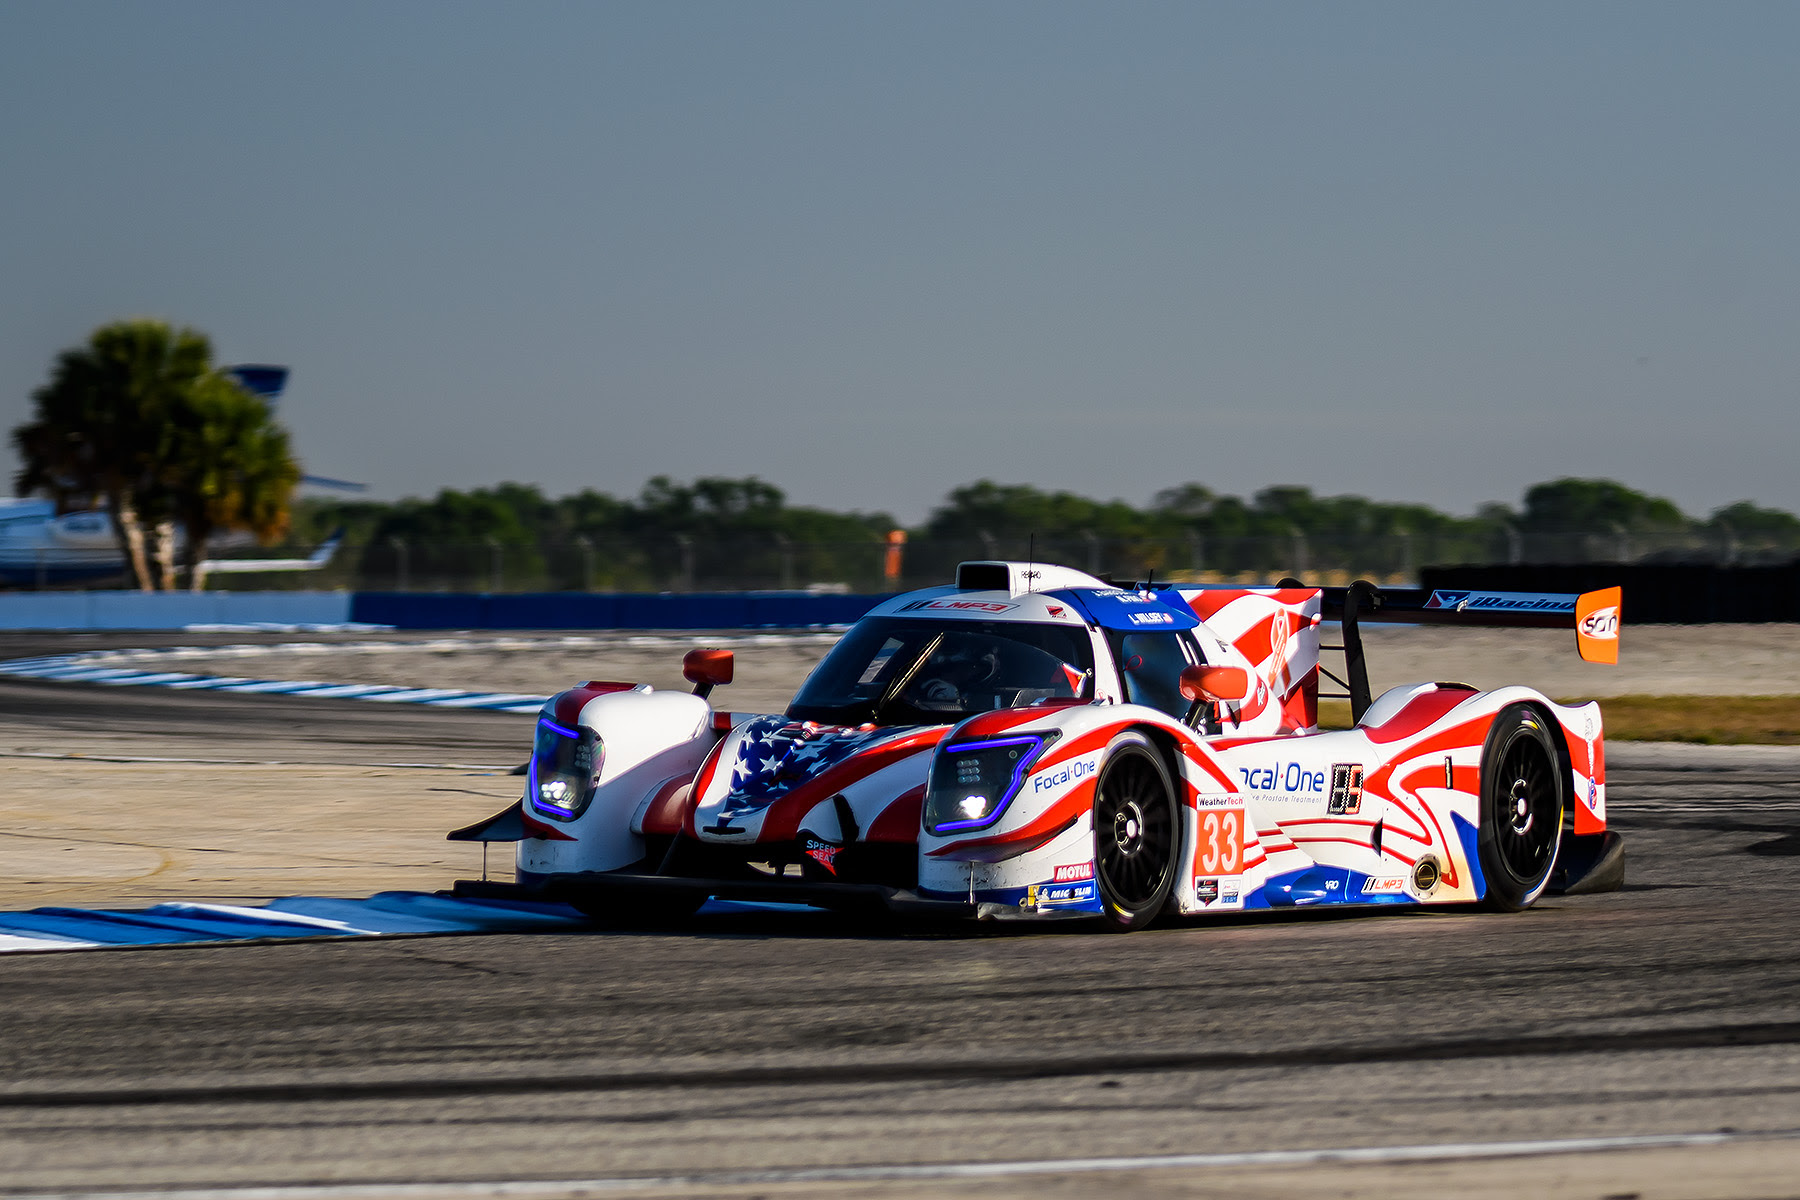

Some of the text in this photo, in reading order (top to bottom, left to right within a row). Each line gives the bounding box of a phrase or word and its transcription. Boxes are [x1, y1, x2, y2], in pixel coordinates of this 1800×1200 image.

[927, 602, 1009, 611] LMP3
[1199, 797, 1243, 806] WeatherTech
[1262, 794, 1288, 802] Prostate
[1291, 794, 1322, 803] Treatment
[806, 840, 836, 854] SPEED
[1202, 812, 1237, 872] 33
[812, 851, 835, 863] SEAT
[1056, 864, 1091, 880] MOTUL
[1374, 880, 1403, 889] LMP3
[1050, 887, 1092, 898] MICELIN
